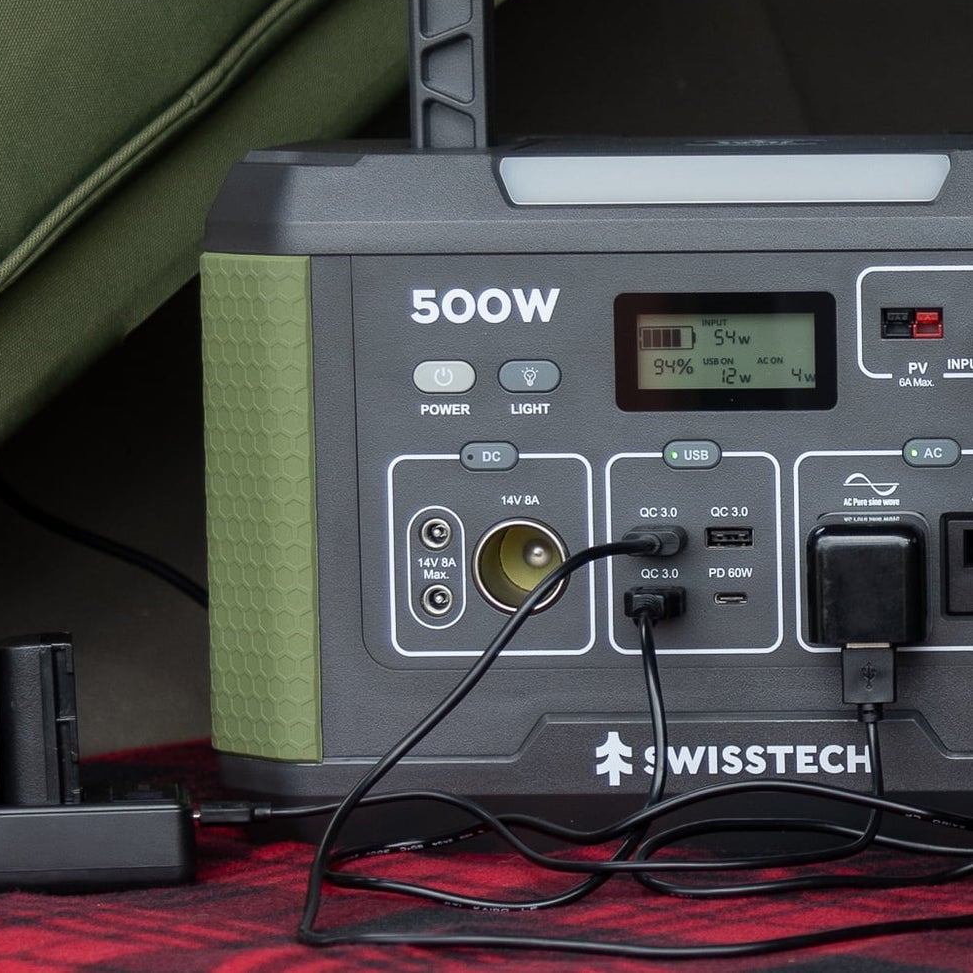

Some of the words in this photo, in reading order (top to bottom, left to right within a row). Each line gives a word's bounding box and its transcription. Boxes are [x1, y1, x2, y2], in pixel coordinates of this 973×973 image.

[410, 287, 561, 325] 500W
[702, 318, 728, 327] INPUT
[653, 358, 694, 375] 94%
[702, 357, 719, 366] USB
[720, 357, 734, 366] ON
[757, 357, 769, 365] AC
[770, 357, 784, 365] ON
[908, 362, 928, 375] PV
[898, 377, 912, 387] 6A
[913, 377, 935, 387] Max.
[420, 403, 471, 416] POWER
[510, 403, 551, 415] LIGHT
[481, 451, 502, 462] DC
[683, 449, 710, 460] USB
[923, 447, 943, 459] AC
[501, 495, 522, 506] 14V
[524, 495, 540, 506] 8A
[843, 497, 853, 506] AC
[640, 507, 659, 518] QC
[660, 507, 678, 517] 3.0
[710, 506, 730, 518] QC
[731, 506, 749, 517] 3.0
[417, 557, 439, 568] 14V
[441, 557, 457, 568] 8A
[423, 569, 450, 580] Max.
[640, 568, 660, 580] QC
[661, 568, 679, 579] 3.0
[708, 567, 725, 578] PD
[727, 567, 753, 578] 60W
[643, 744, 872, 775] SWISSTECH
